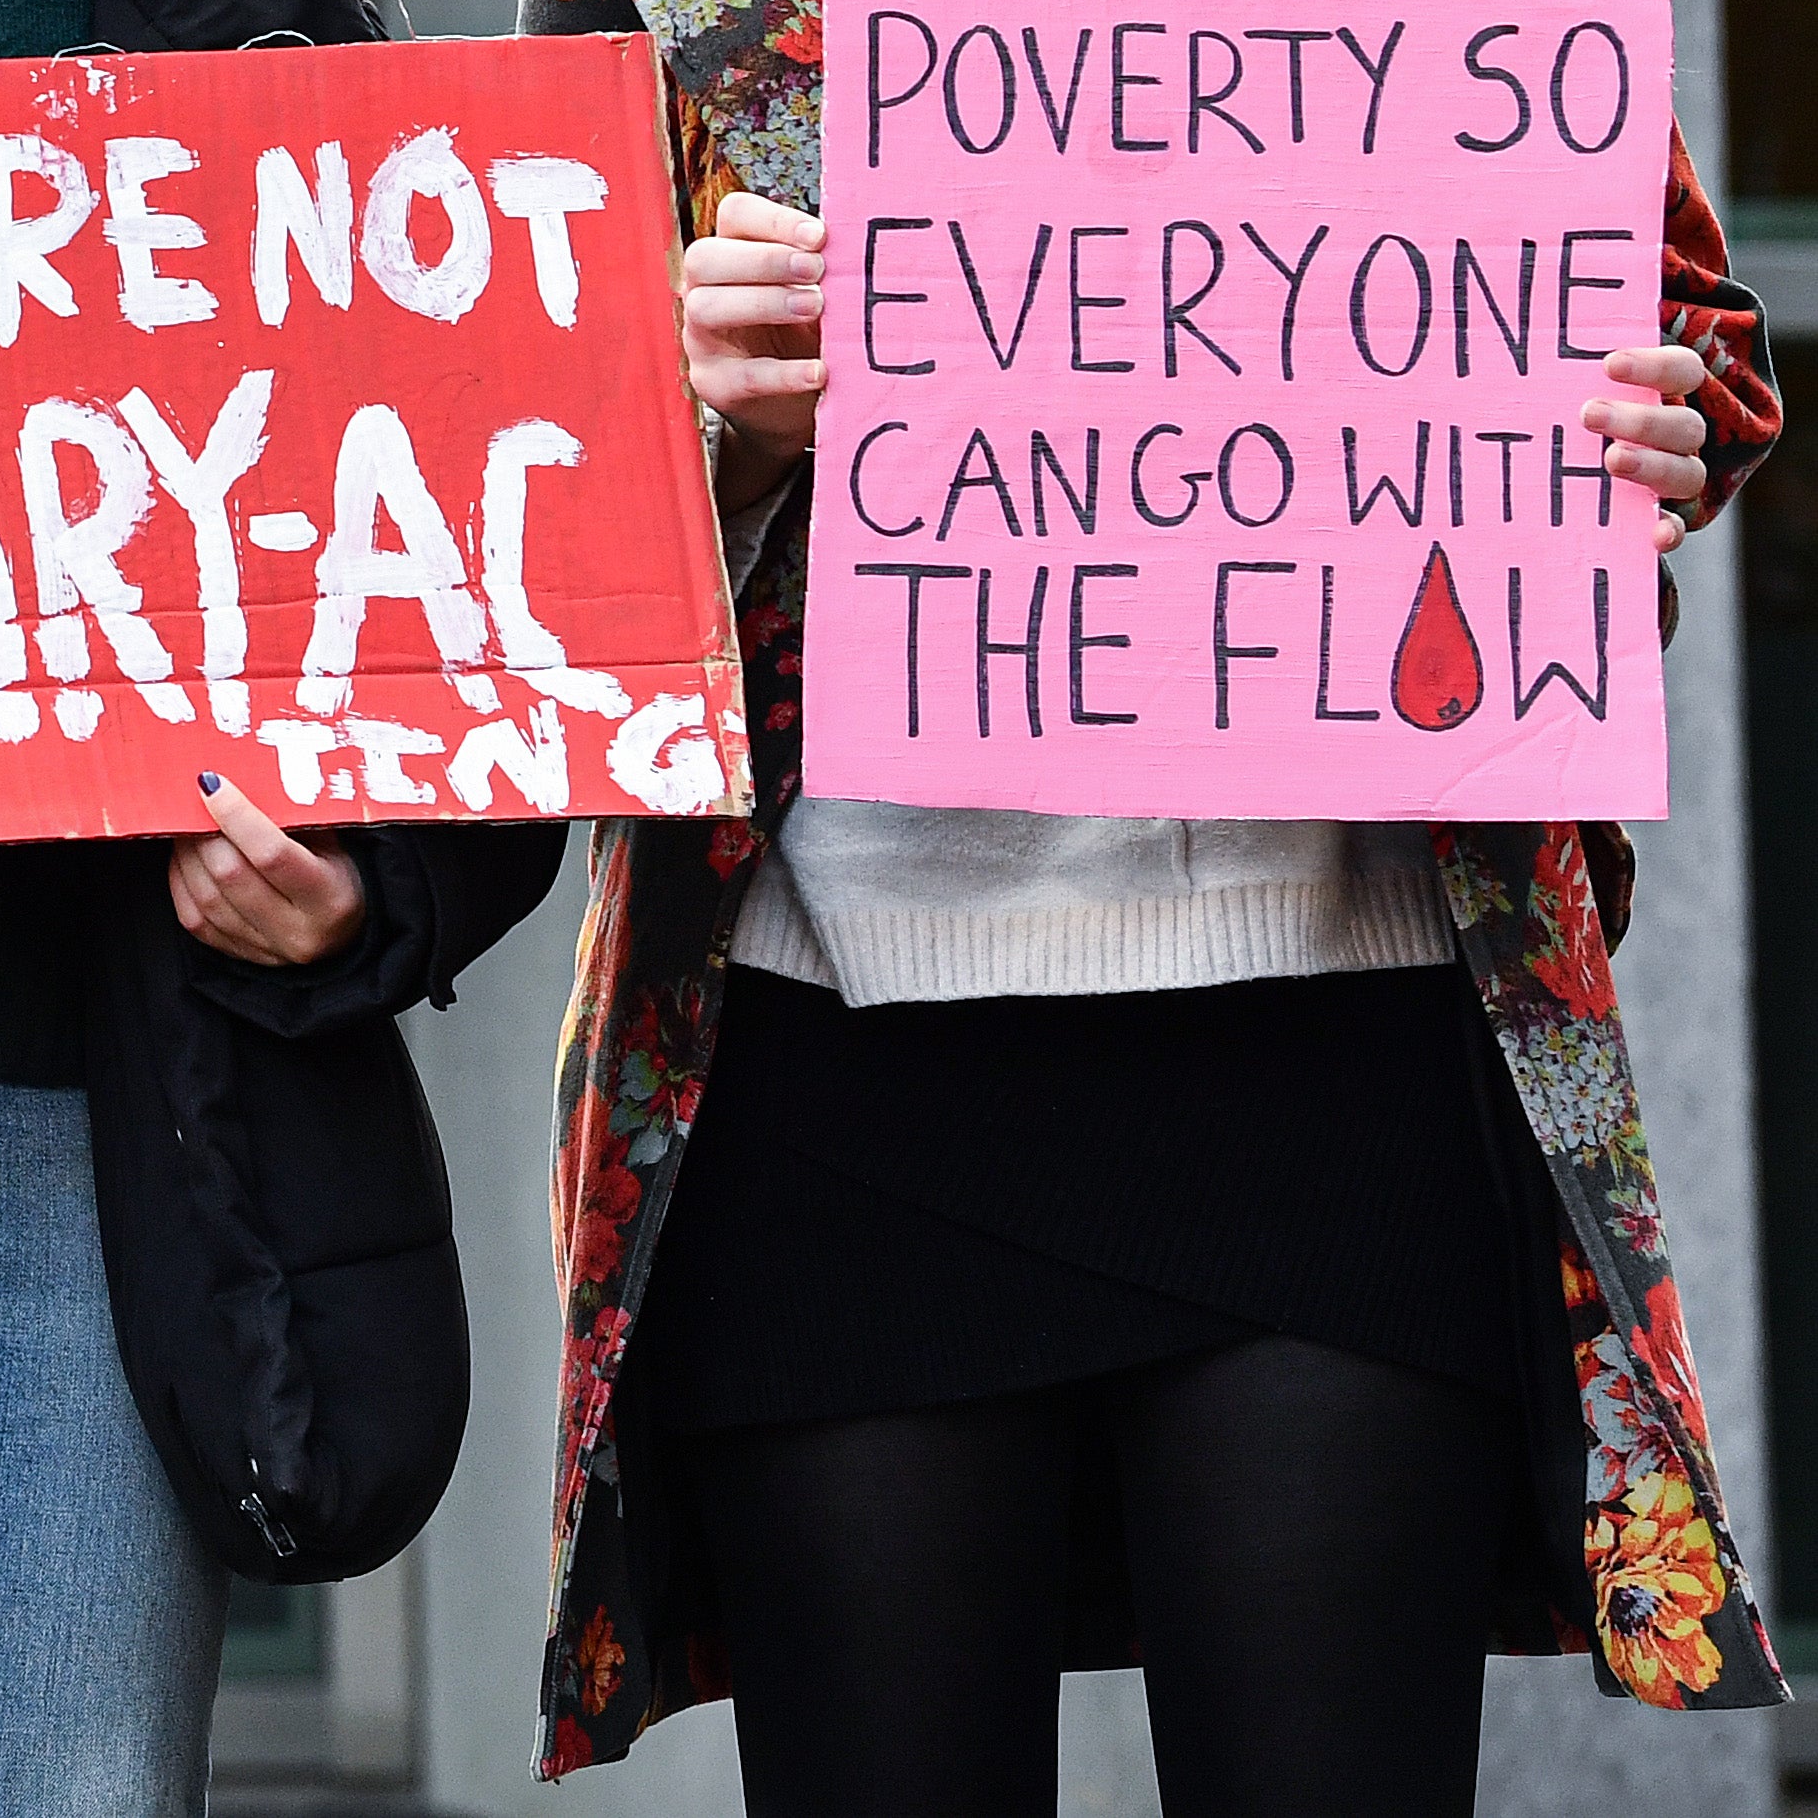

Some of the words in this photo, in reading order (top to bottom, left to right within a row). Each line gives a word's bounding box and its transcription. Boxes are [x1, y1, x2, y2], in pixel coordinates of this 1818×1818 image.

[867, 10, 1406, 168] POVERTY
[1454, 20, 1630, 154] SO
[249, 123, 609, 332] NOT
[862, 217, 1636, 383] EVERYONE
[1343, 420, 1613, 529] WITH
[855, 562, 1139, 739] THE
